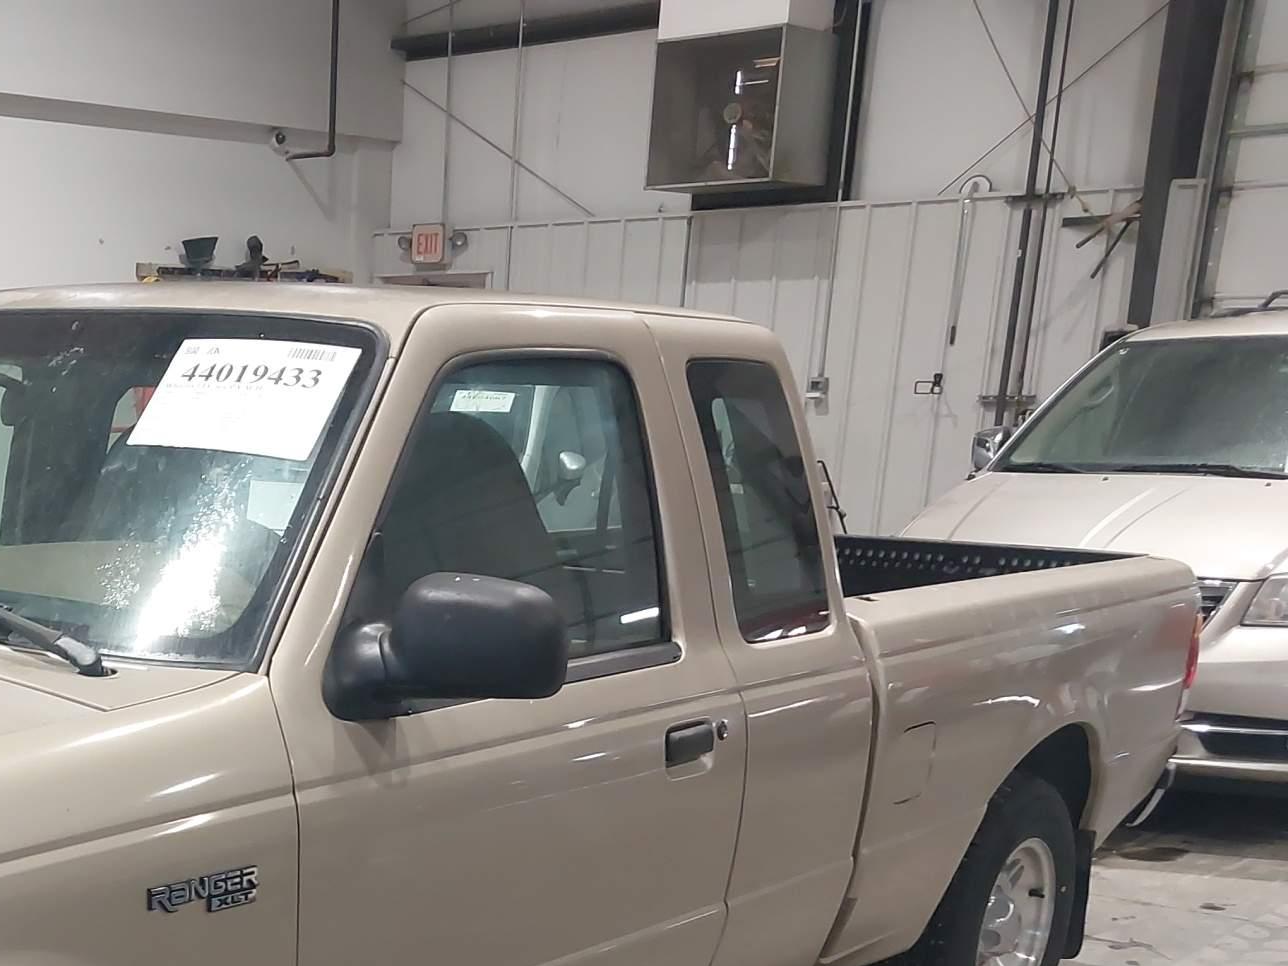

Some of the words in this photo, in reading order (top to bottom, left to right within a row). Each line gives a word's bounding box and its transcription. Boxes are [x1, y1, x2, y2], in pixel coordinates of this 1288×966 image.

[417, 232, 440, 255] EXIT
[181, 363, 323, 389] 44019433
[147, 865, 259, 913] RANGER
[209, 889, 257, 912] XLT
